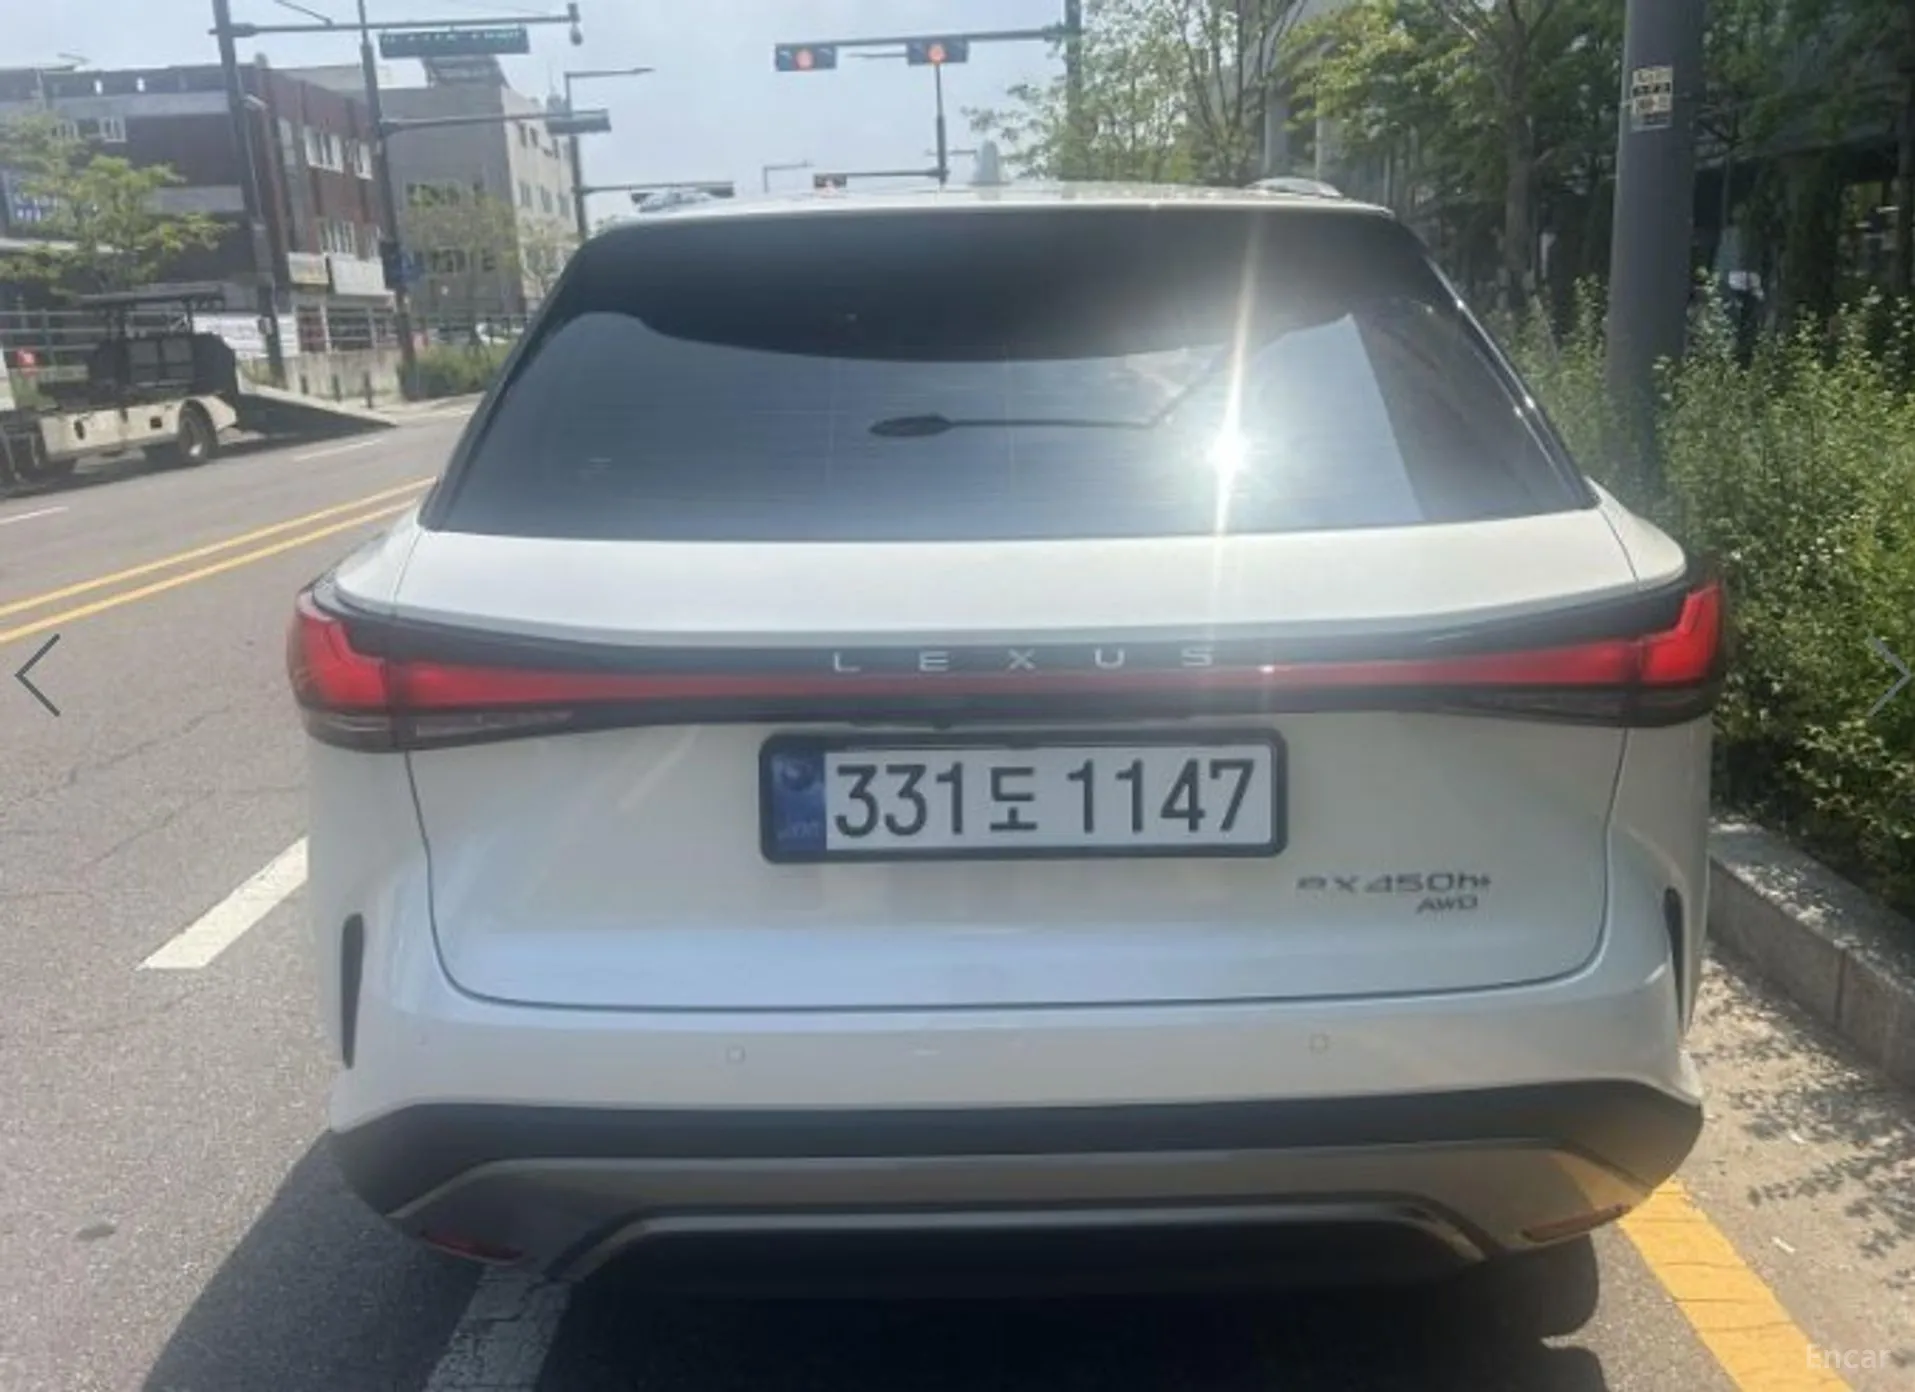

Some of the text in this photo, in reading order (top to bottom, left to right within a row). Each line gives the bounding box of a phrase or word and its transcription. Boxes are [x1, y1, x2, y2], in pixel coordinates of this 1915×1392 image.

[833, 647, 1214, 673] LEXUS
[1067, 757, 1256, 834] 1147
[1416, 895, 1478, 912] AWD
